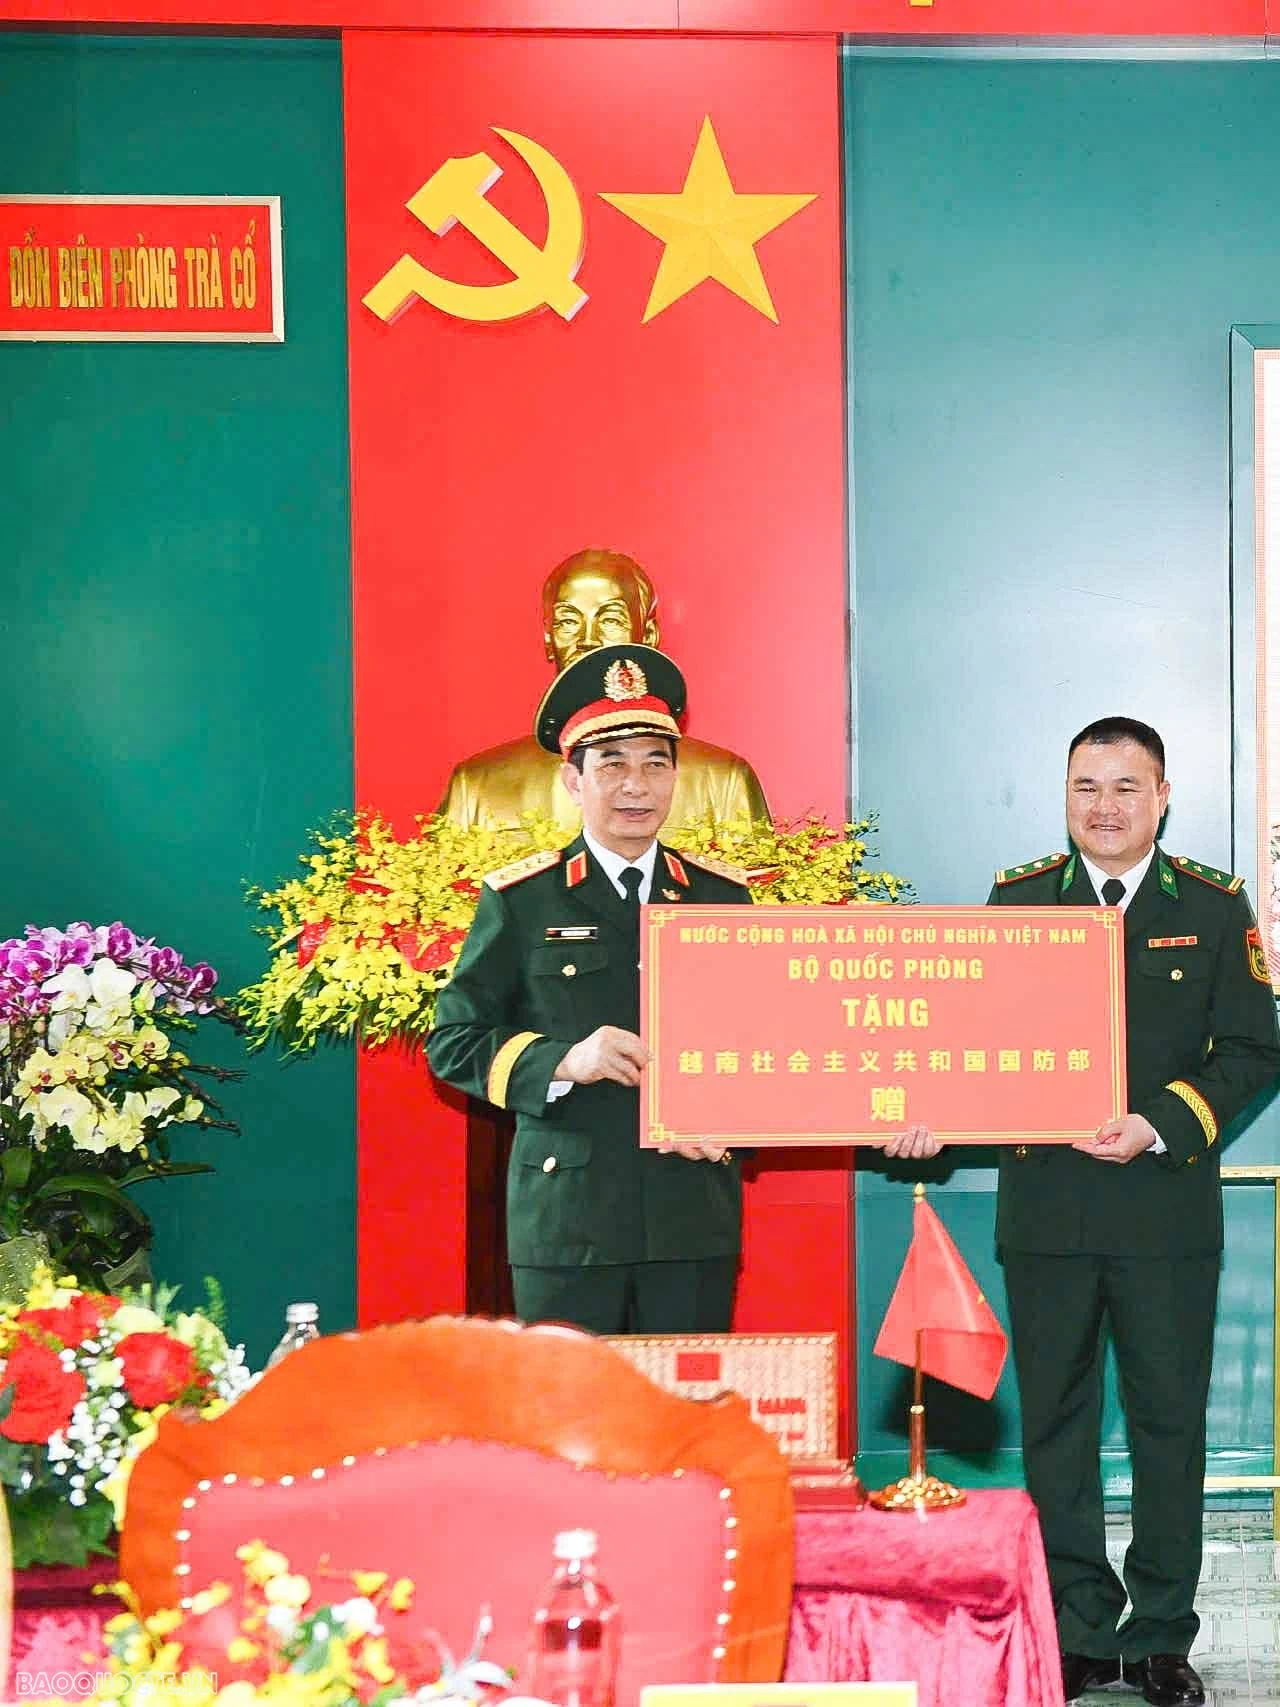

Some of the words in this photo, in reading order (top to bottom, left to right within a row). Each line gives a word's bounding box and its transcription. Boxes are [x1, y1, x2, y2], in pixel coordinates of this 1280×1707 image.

[57, 233, 103, 308] BIÊN
[110, 232, 177, 308] PHÒNG
[184, 234, 224, 308] TRÀ
[680, 925, 730, 944] NƯỚC
[736, 924, 785, 949] CỘNG
[792, 924, 828, 944] HOÀ
[835, 924, 857, 944] XÃ
[864, 924, 894, 946] HỘI
[944, 925, 997, 944] NGHĨA
[1004, 925, 1041, 947] VIỆT
[1048, 928, 1087, 945] NAM
[788, 955, 820, 982] BỘ
[830, 952, 893, 981] QUỐC
[904, 954, 984, 980] PHÒNG
[842, 993, 929, 1034] TẶNG
[679, 1048, 1091, 1074] 越南社会主义共和国国防部
[870, 1087, 907, 1122] 赠
